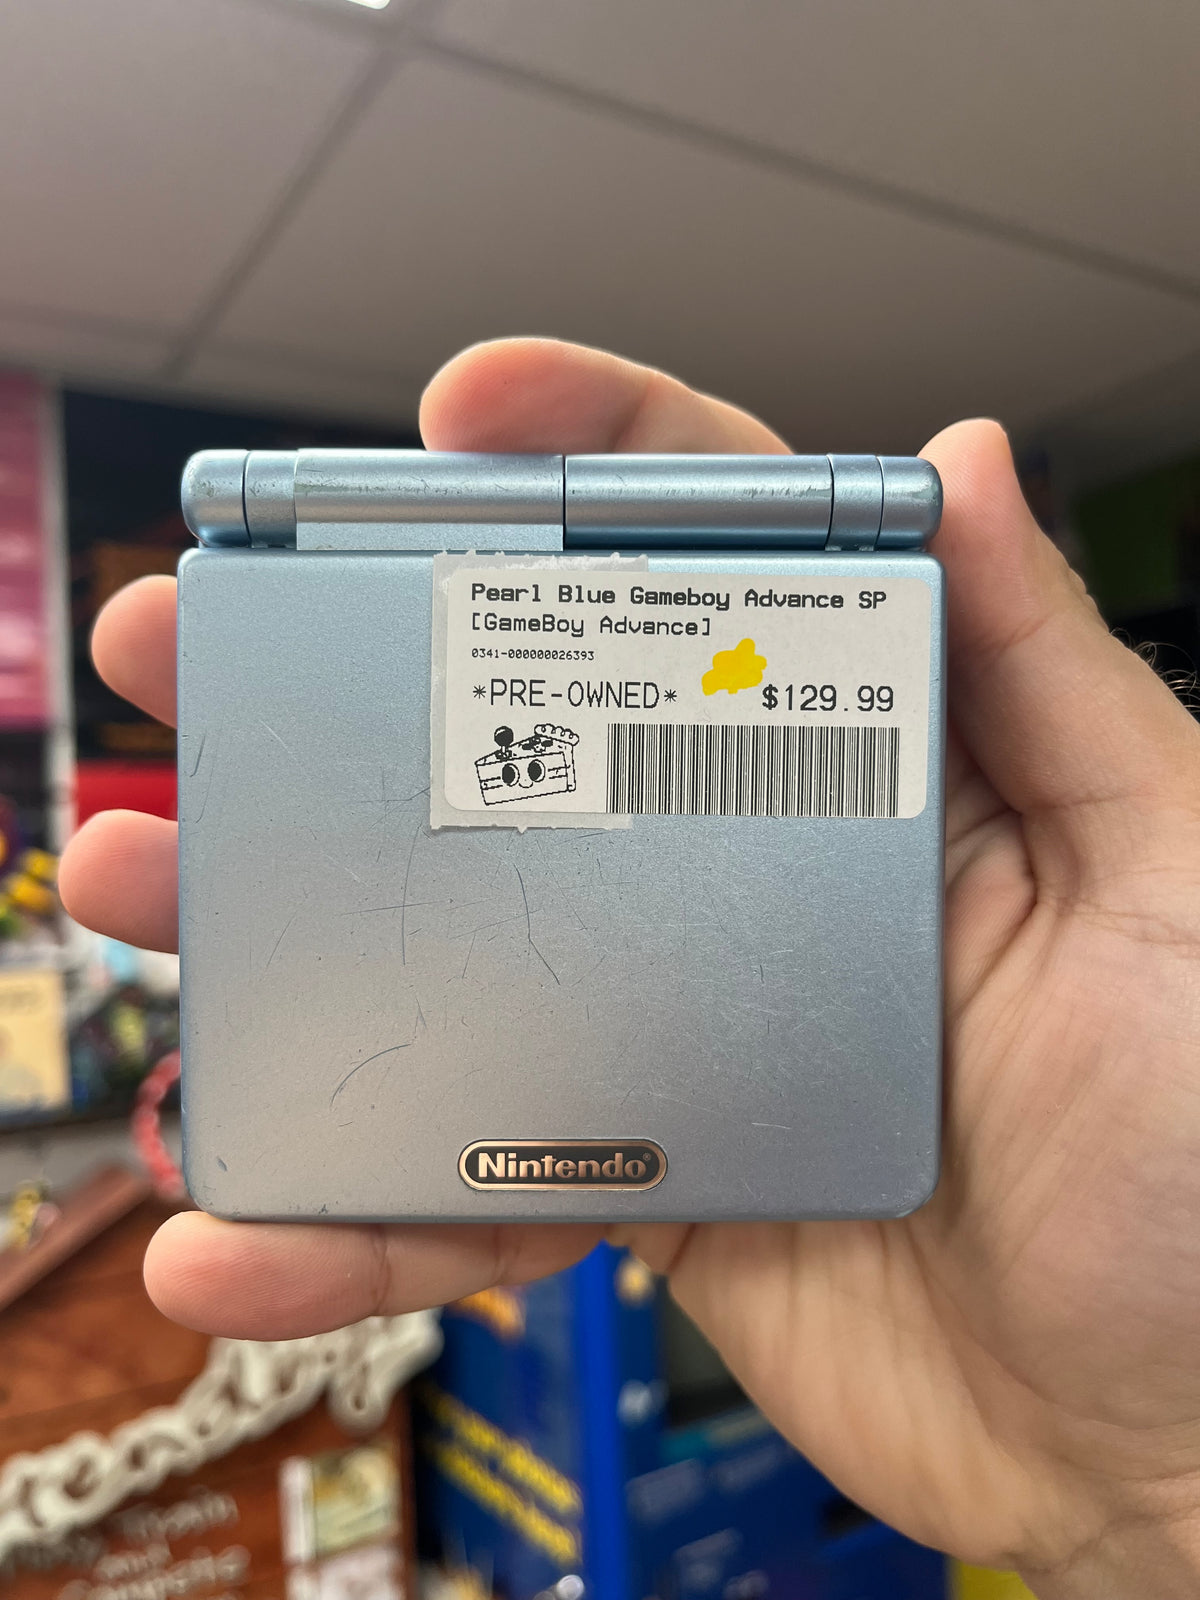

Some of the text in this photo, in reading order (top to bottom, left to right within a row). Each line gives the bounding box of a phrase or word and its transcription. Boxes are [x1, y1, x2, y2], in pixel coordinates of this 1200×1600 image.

[472, 582, 888, 612] Pearl Blue Gameboy Advance SP
[472, 613, 711, 638] [GameBoy Advance]
[471, 647, 595, 661] 0341-000000026393
[762, 684, 894, 713] $129.99
[478, 1152, 647, 1179] Nintendo
